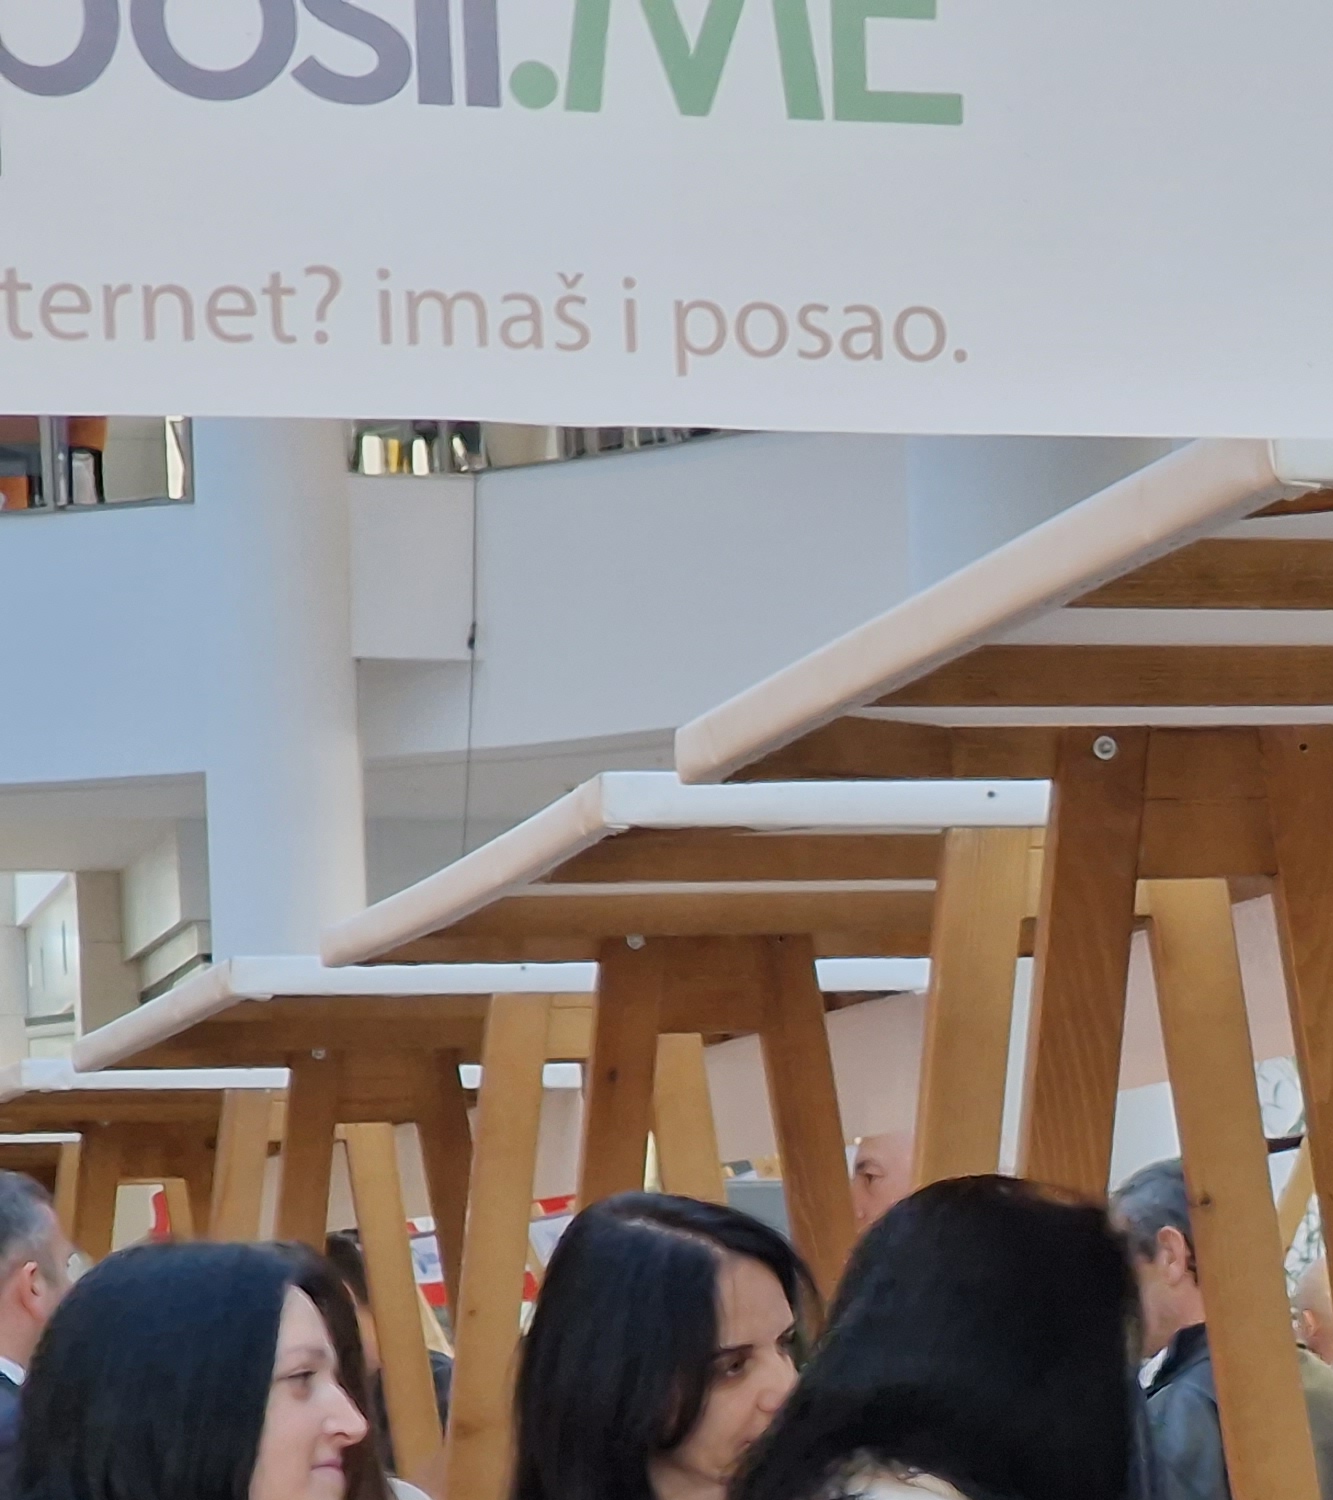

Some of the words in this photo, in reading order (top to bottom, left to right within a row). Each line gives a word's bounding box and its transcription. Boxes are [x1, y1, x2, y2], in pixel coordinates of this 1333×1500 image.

[376, 268, 591, 353] imaš
[622, 276, 639, 354] i
[673, 293, 969, 376] posao.
